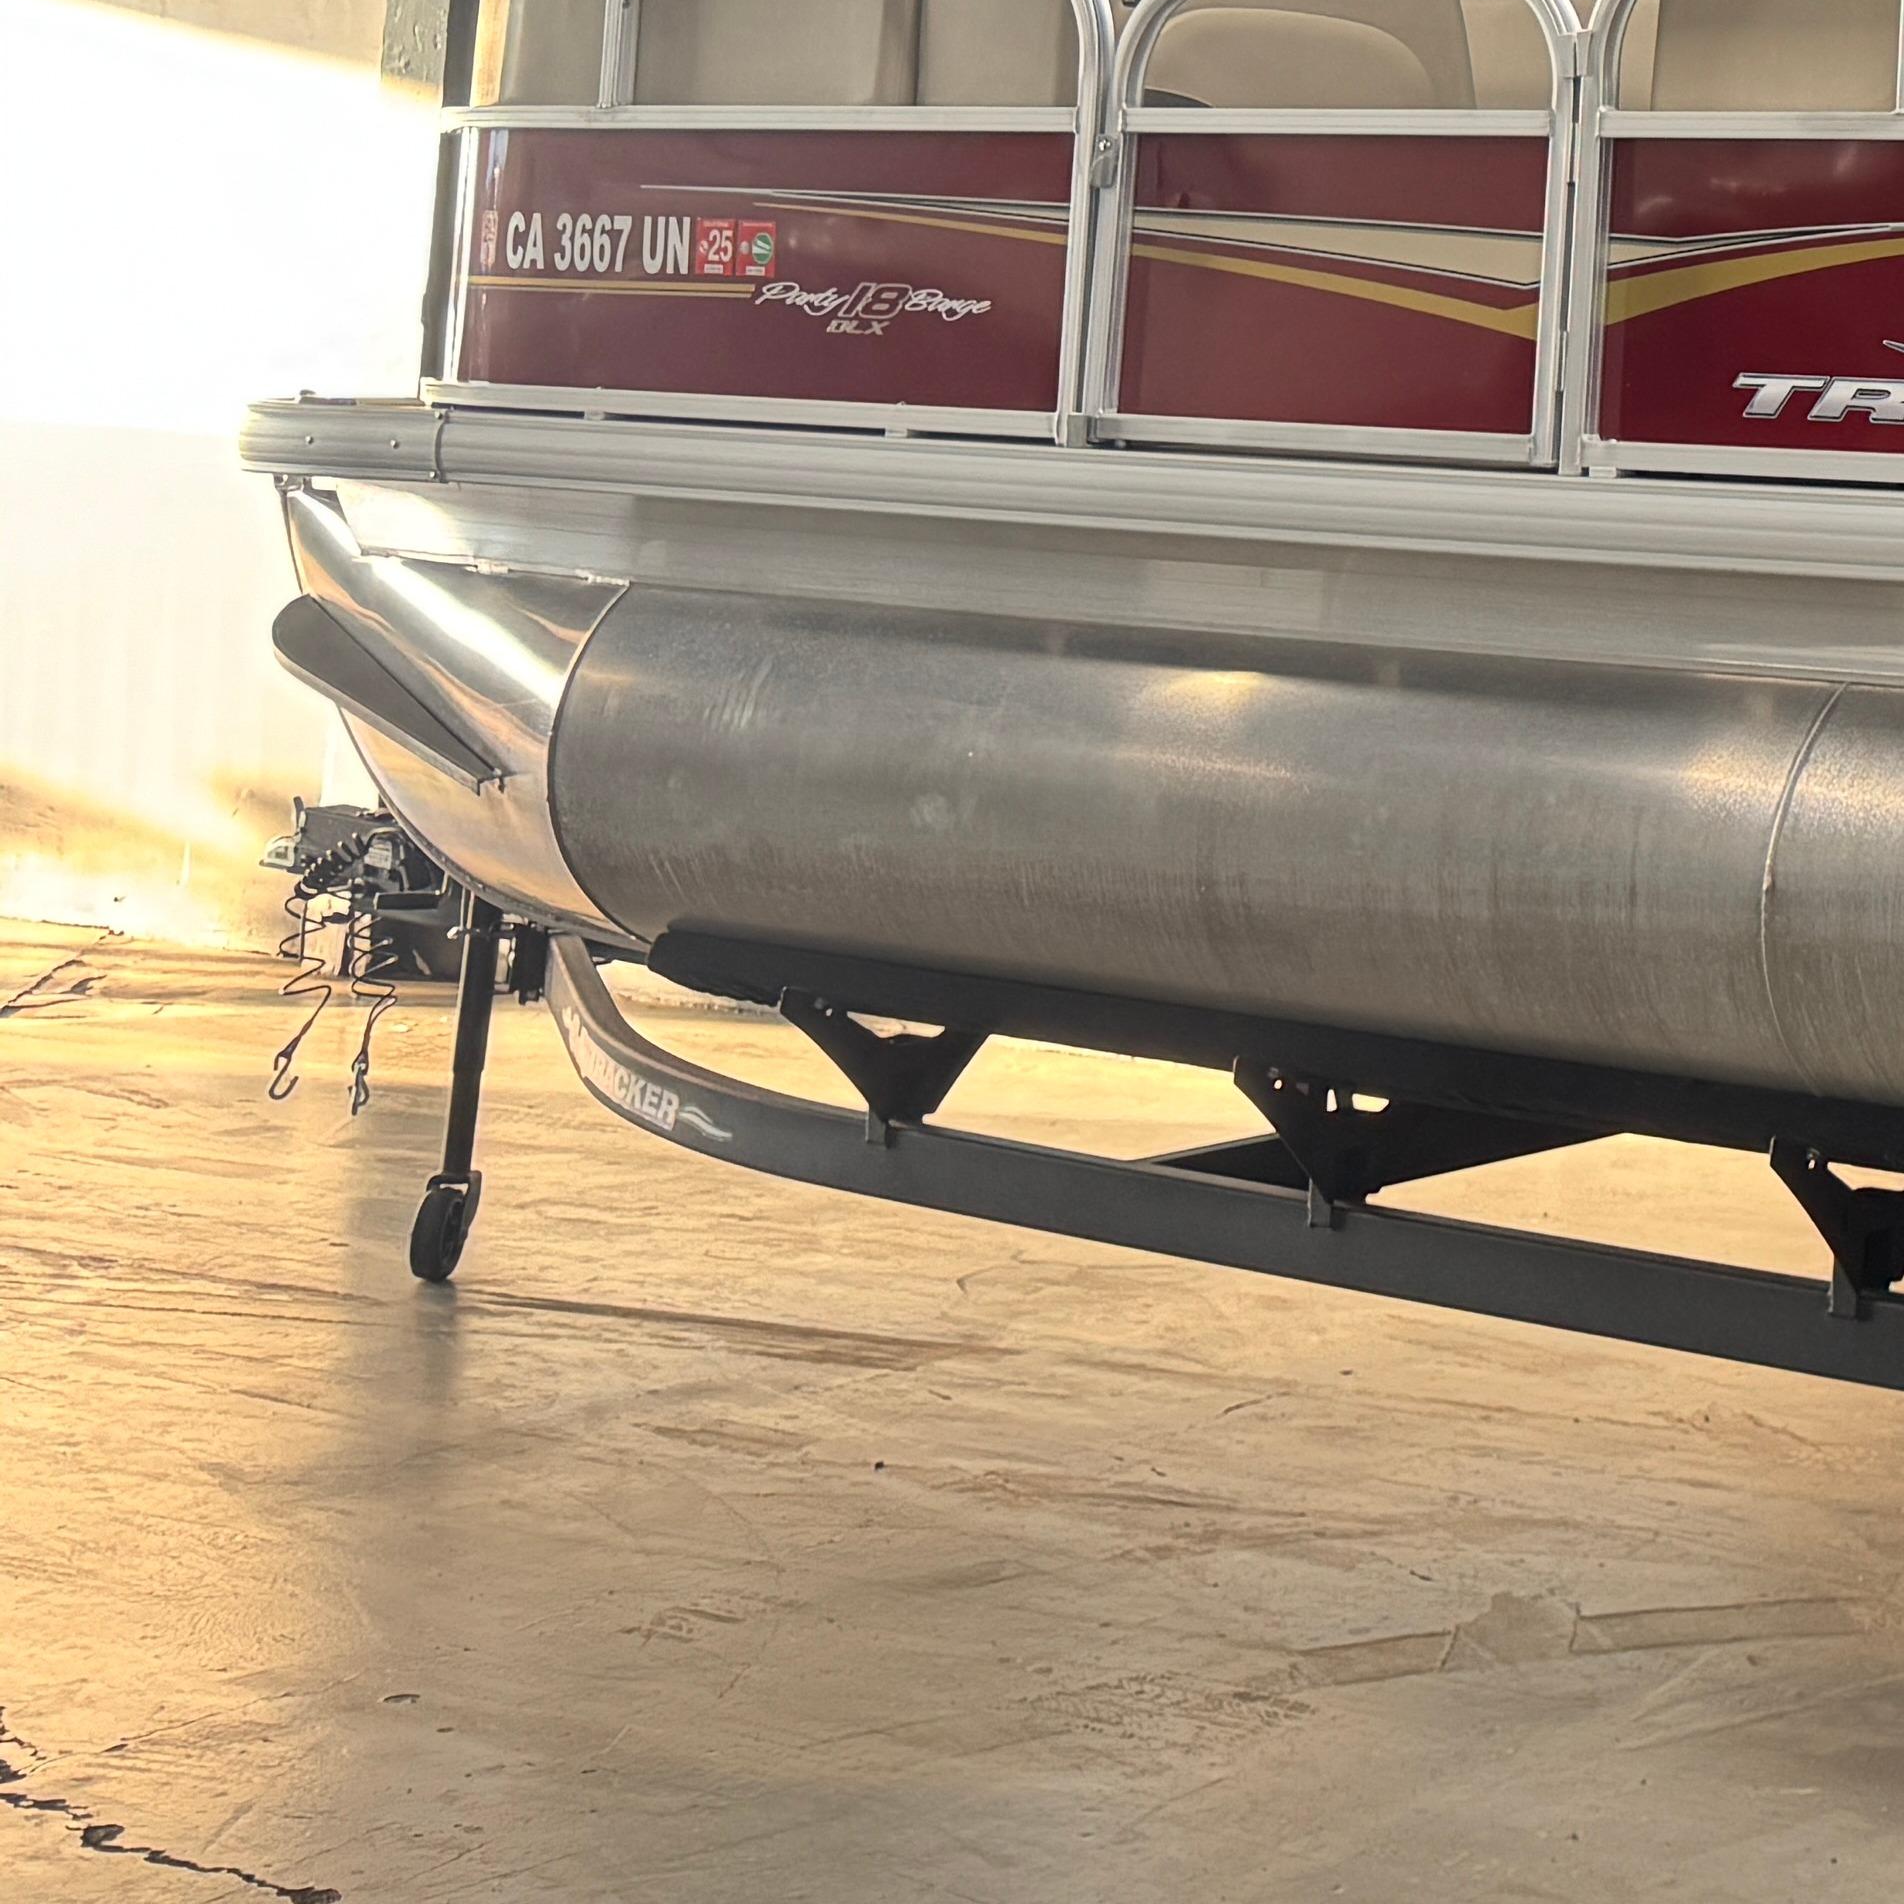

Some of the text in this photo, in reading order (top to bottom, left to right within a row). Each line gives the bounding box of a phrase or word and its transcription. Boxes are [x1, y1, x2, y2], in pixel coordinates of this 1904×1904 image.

[506, 211, 691, 275] CA 3667 UN
[708, 228, 734, 263] 25
[755, 281, 992, 321] Party 18 Barge
[826, 319, 890, 335] DLX
